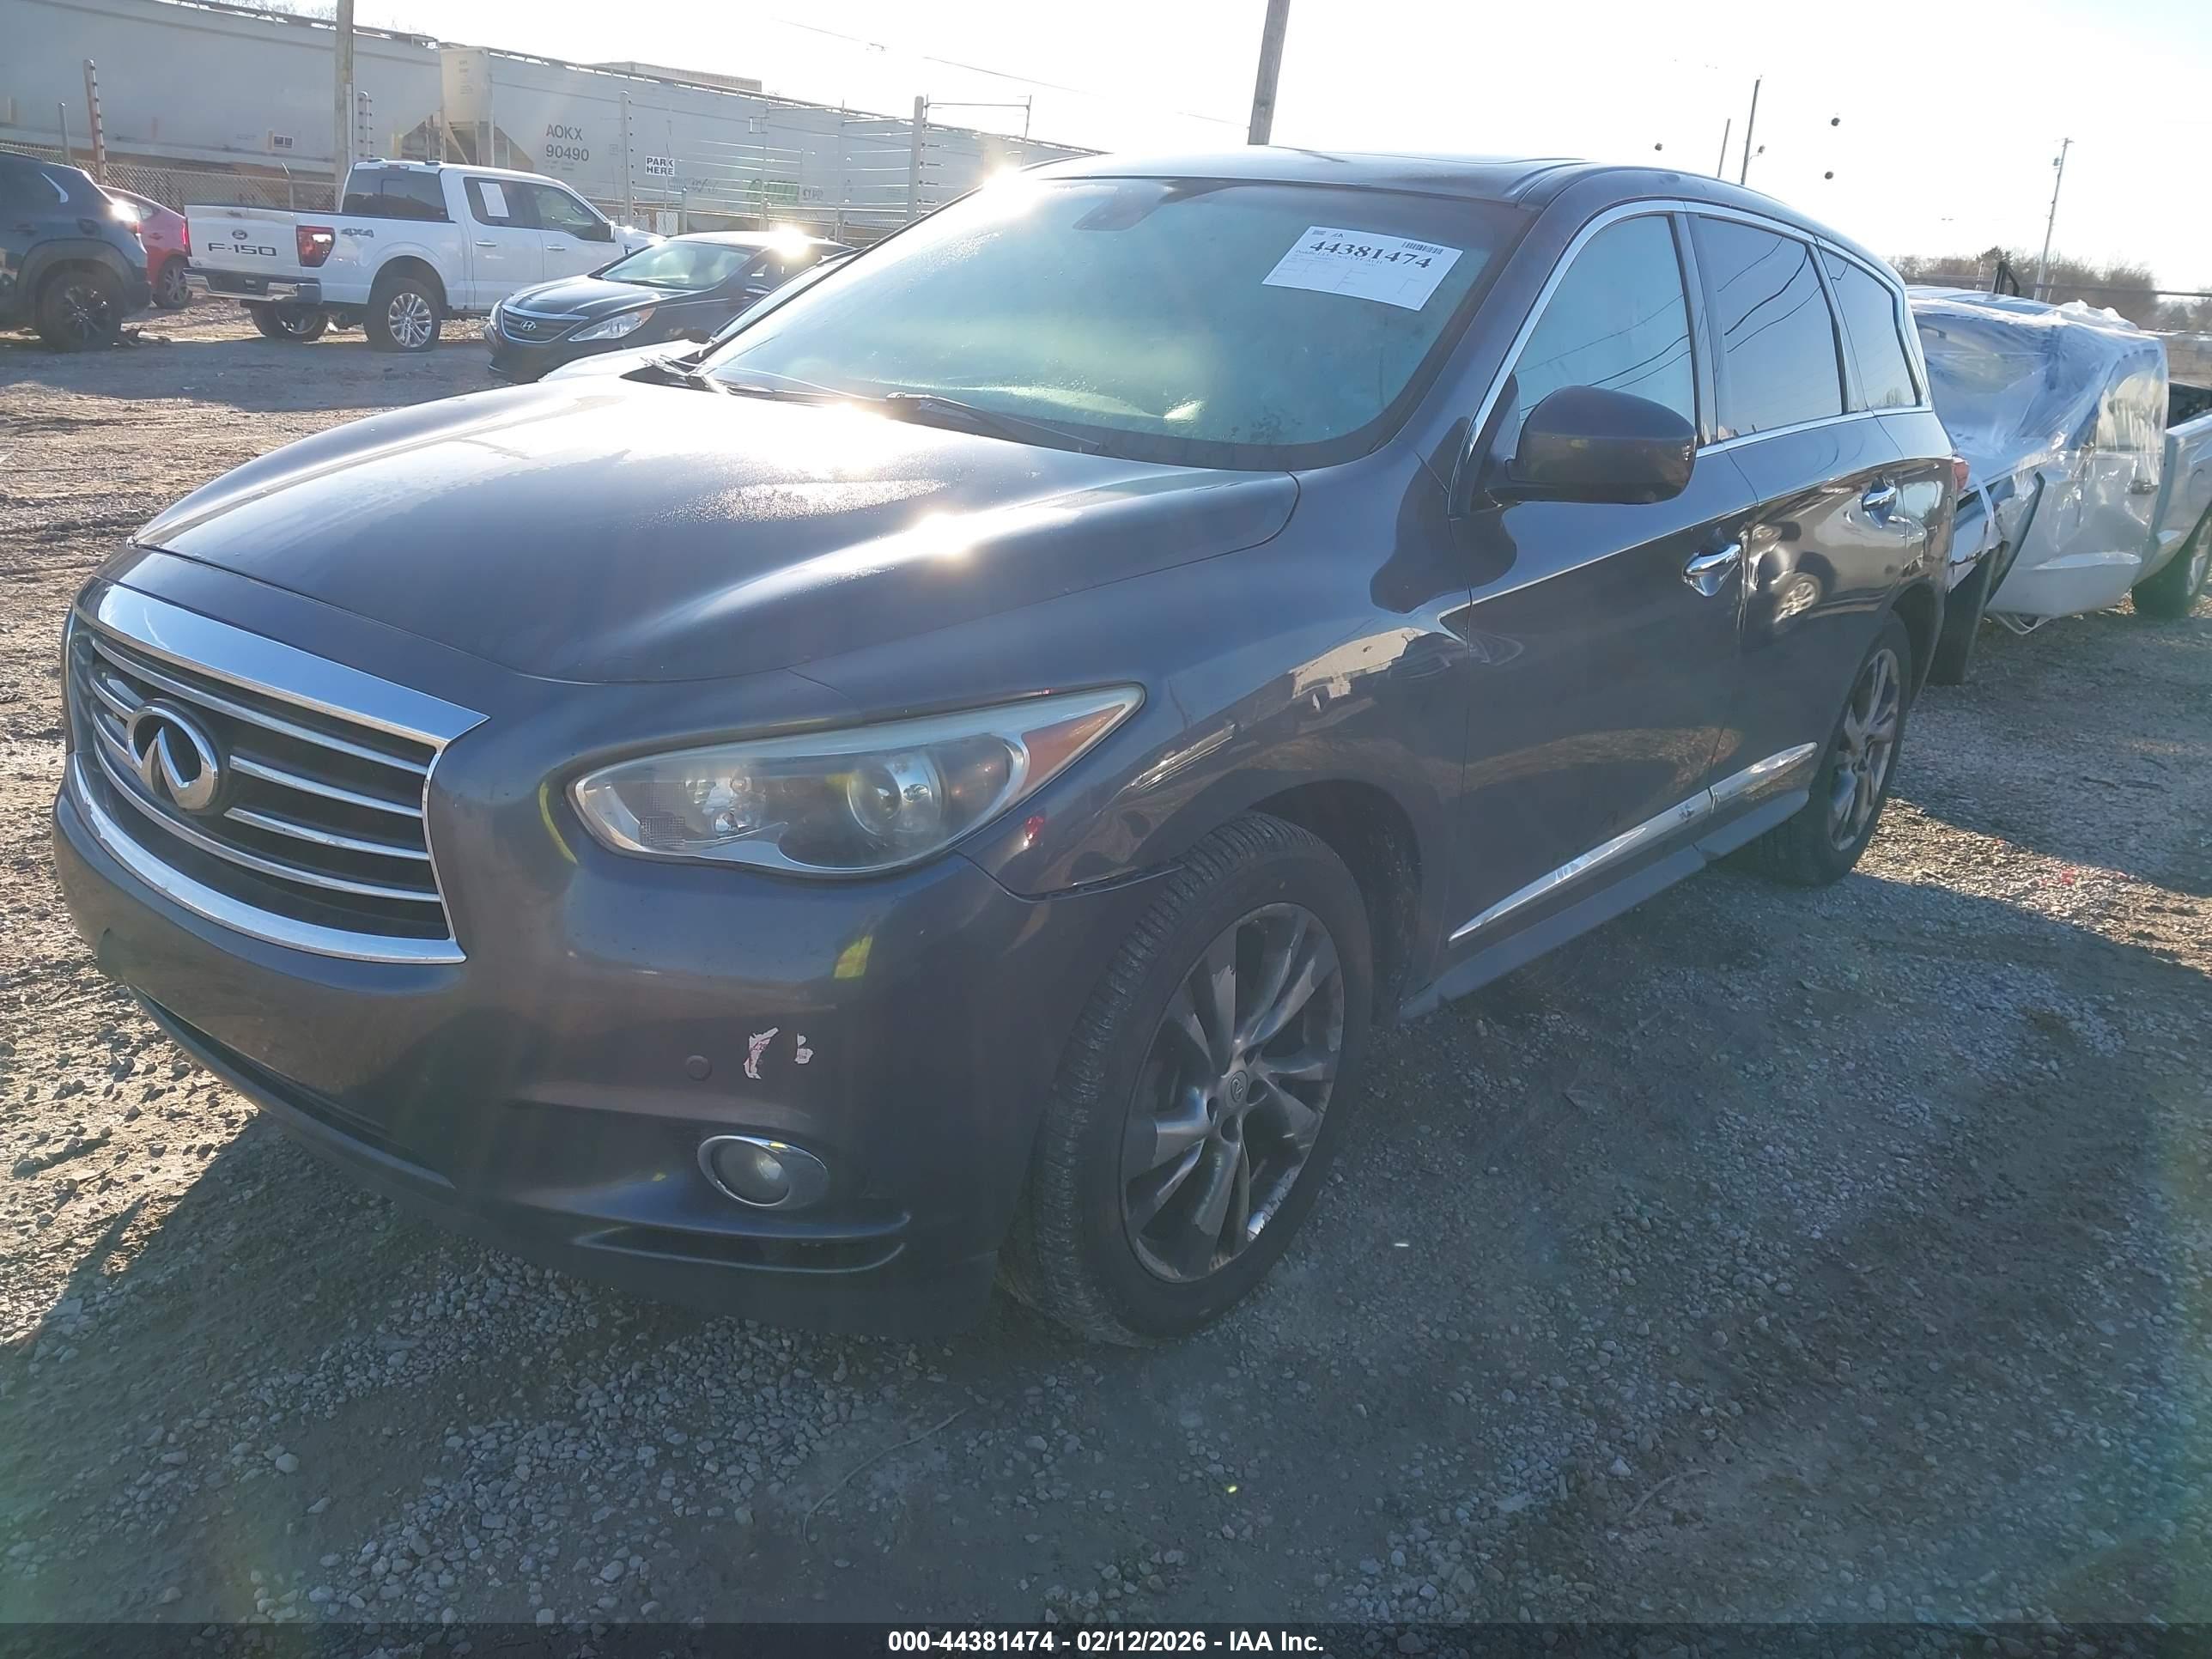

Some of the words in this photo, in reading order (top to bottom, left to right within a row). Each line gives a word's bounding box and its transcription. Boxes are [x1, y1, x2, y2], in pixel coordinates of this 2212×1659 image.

[546, 124, 583, 141] AOKX
[546, 144, 590, 161] 90490
[646, 157, 673, 167] PARK
[646, 167, 673, 175] HERE
[208, 242, 277, 257] F-150
[1310, 240, 1431, 268] 44381474
